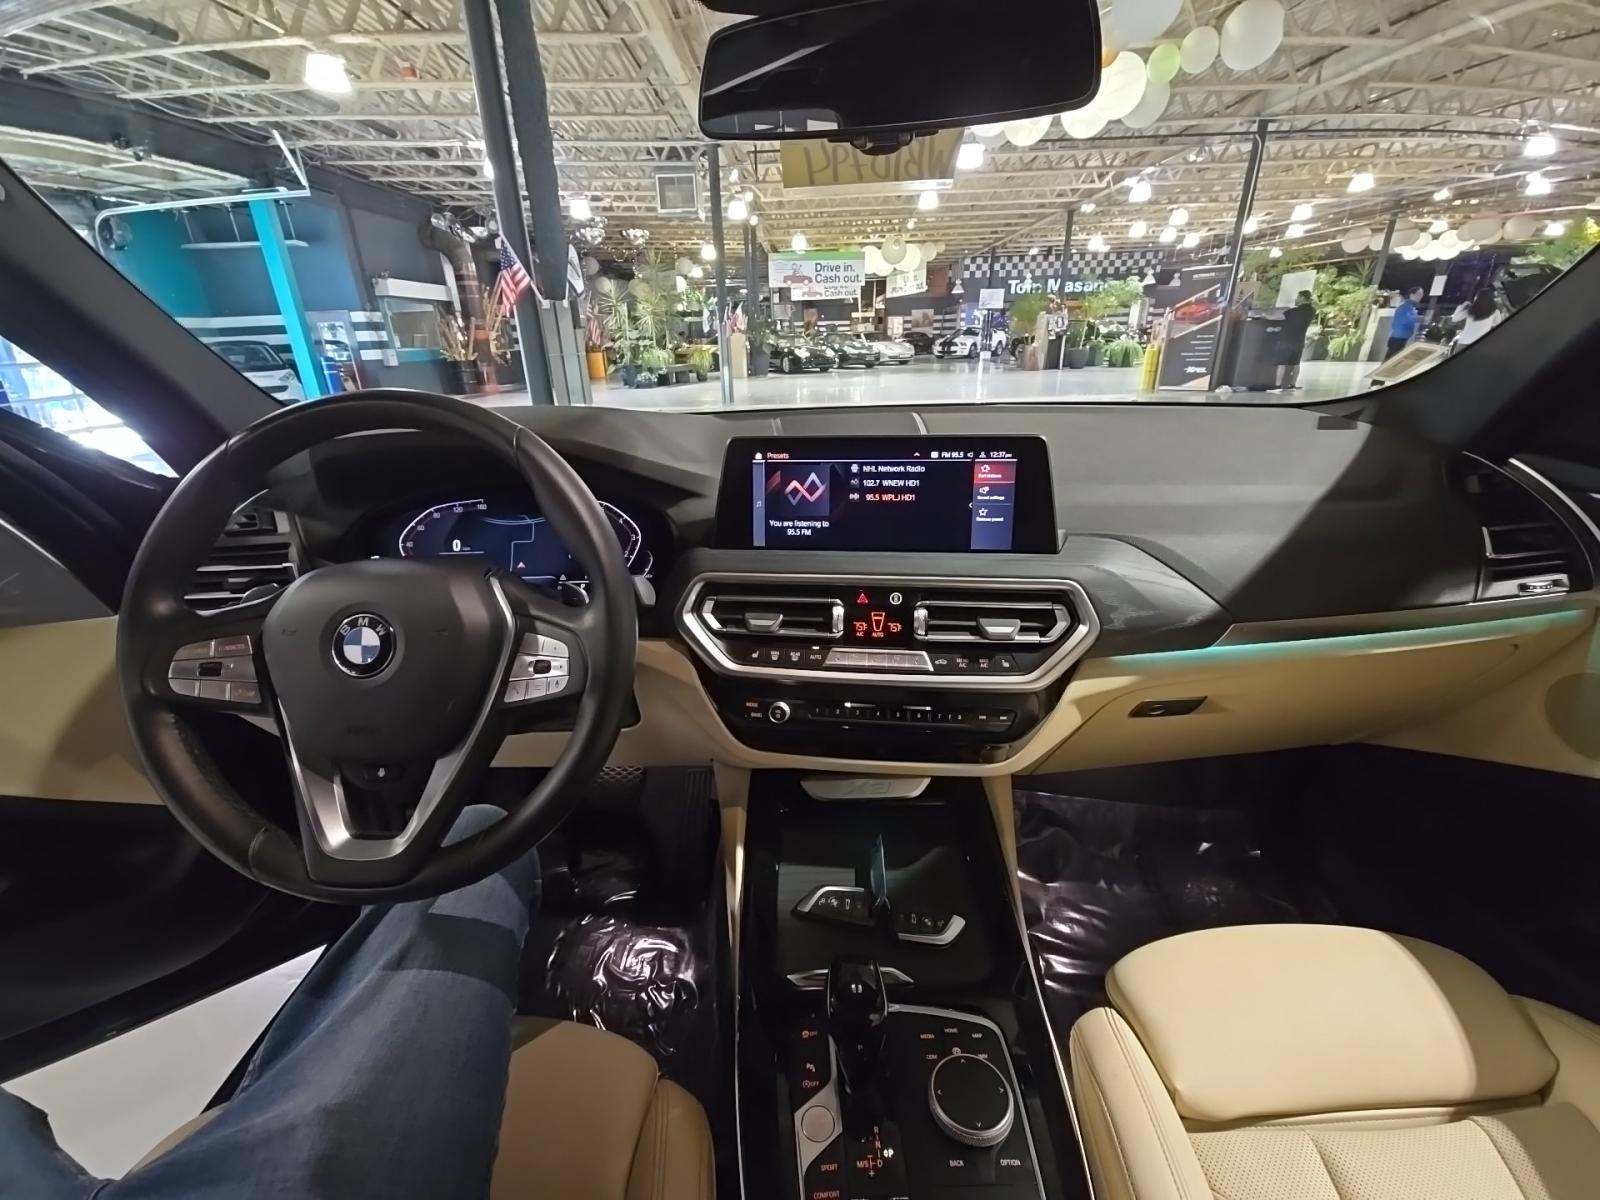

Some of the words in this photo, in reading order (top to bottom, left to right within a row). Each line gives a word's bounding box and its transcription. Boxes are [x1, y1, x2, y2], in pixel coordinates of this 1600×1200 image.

[814, 262, 841, 273] Drive
[843, 262, 856, 273] in.
[814, 273, 841, 284] Cash
[843, 274, 862, 284] out.
[823, 289, 842, 298] Cash
[766, 452, 790, 460] Presets
[862, 465, 877, 473] NHL
[878, 465, 906, 473] Network
[906, 465, 926, 473] Radio
[863, 479, 880, 487] 102.7
[882, 479, 904, 487] WNEW
[905, 479, 920, 487] HD1
[865, 493, 880, 501] 95.5
[901, 493, 916, 501] HD1
[769, 519, 782, 527] You
[794, 519, 822, 529] listening
[787, 528, 801, 536] 95.5
[801, 528, 812, 536] FM
[452, 539, 461, 552] 0
[339, 616, 387, 636] BMW
[821, 1163, 838, 1172] SPORT
[949, 1159, 964, 1167] BACK
[813, 1190, 840, 1200] COMFORT
